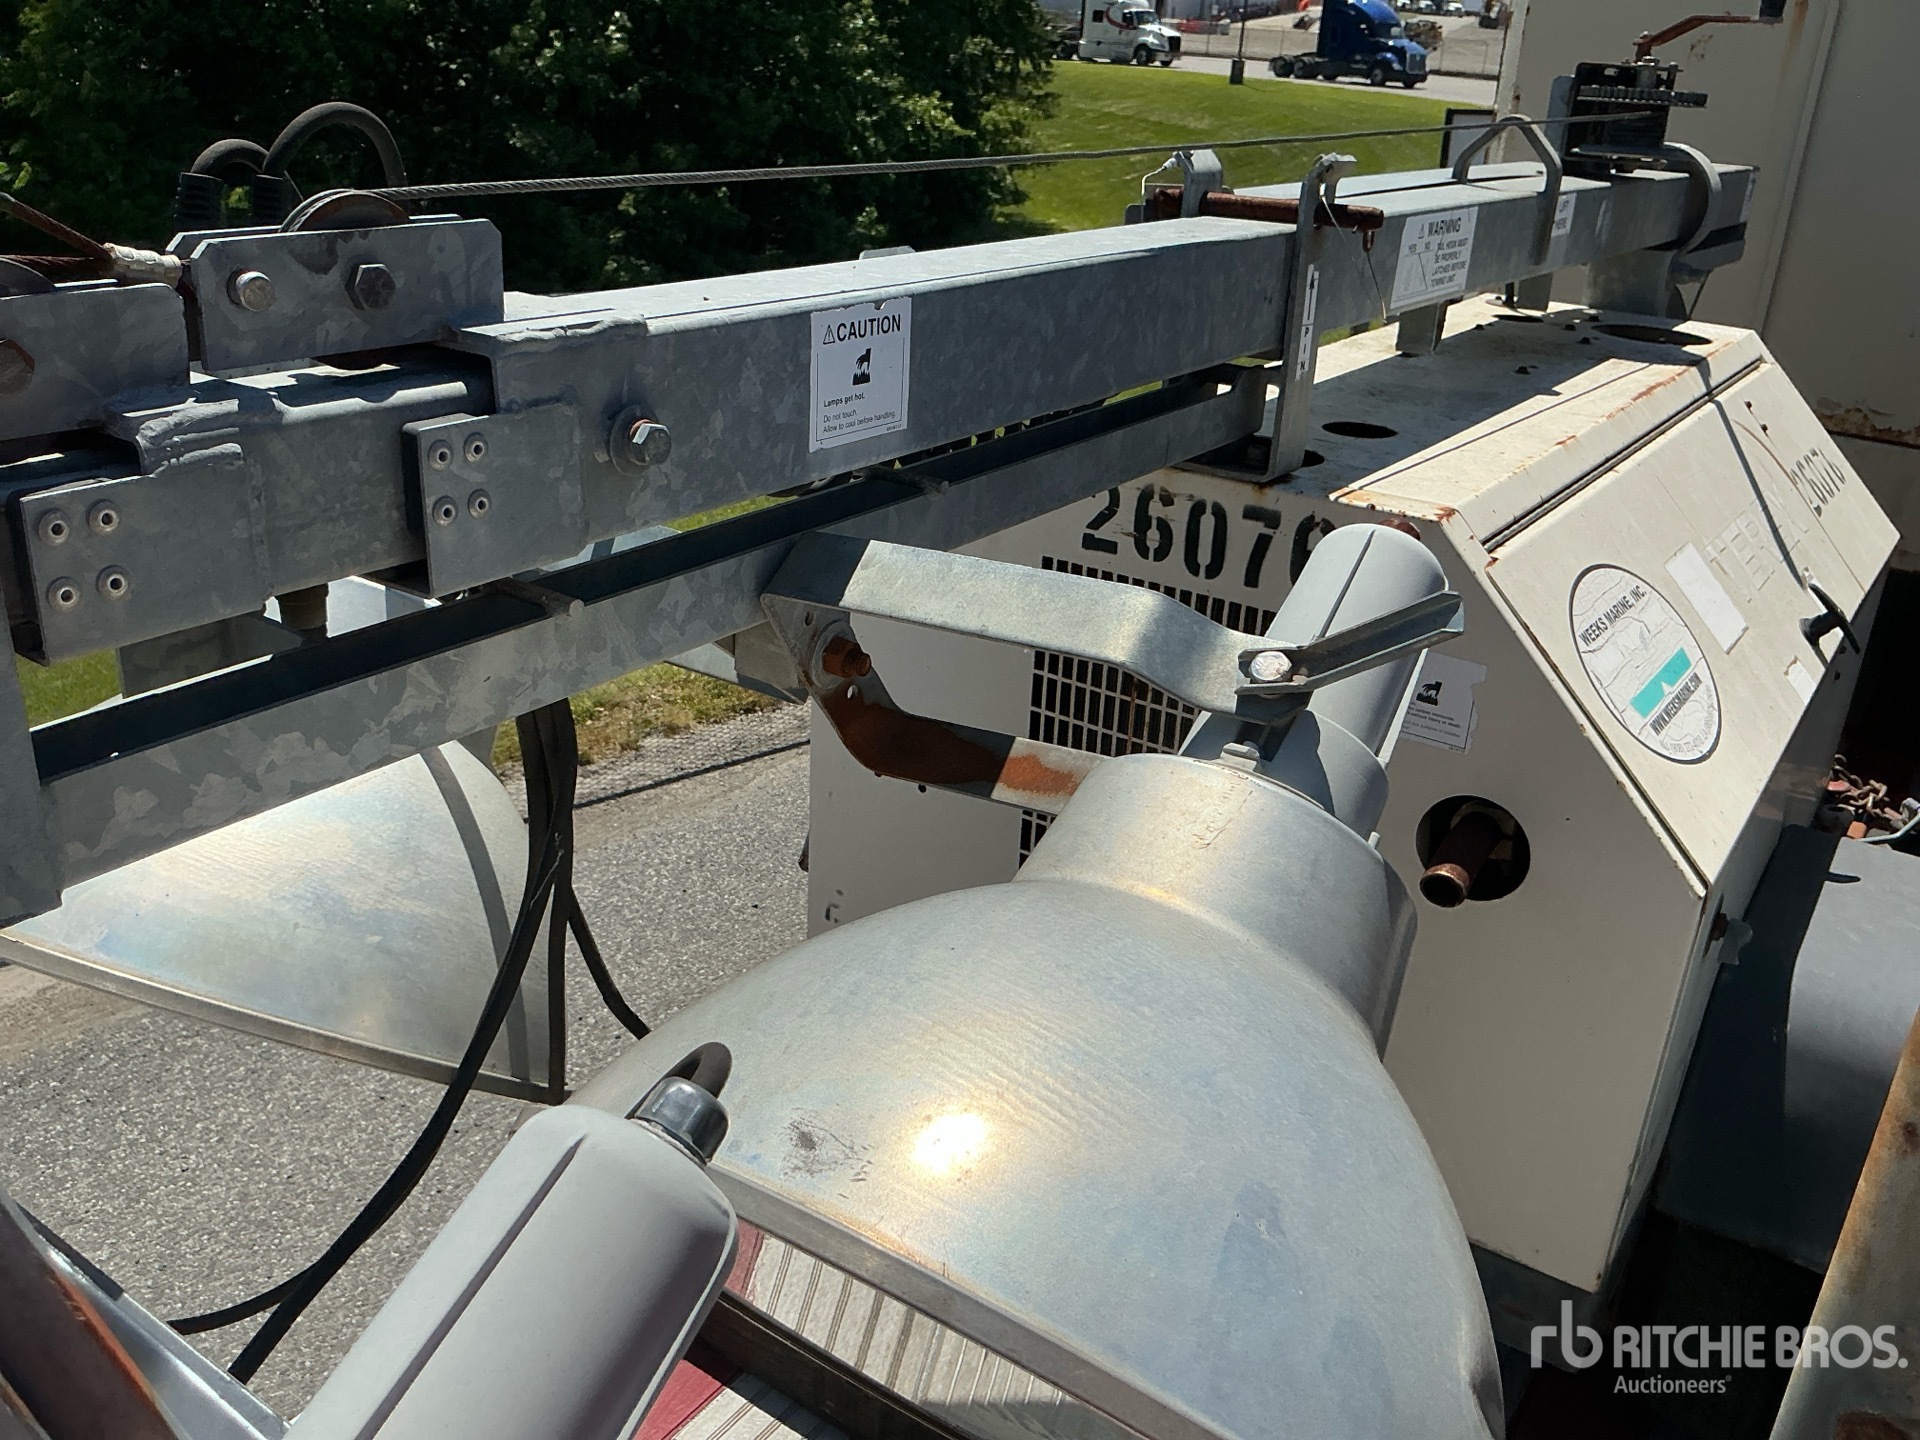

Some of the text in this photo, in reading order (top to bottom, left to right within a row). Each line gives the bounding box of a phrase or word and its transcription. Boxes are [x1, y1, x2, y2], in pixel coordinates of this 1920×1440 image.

[1427, 217, 1462, 237] WARNING
[836, 314, 901, 342] CAUTION
[1300, 327, 1309, 371] PIN
[823, 391, 866, 408] Lamps get hot.
[823, 409, 857, 424] Do not touch.
[823, 410, 897, 434] Allow to cool before handling.
[1578, 585, 1648, 647] WEEKS MARINE, INC.
[1649, 672, 1703, 736] WWW.WEEKSMARINE.COM
